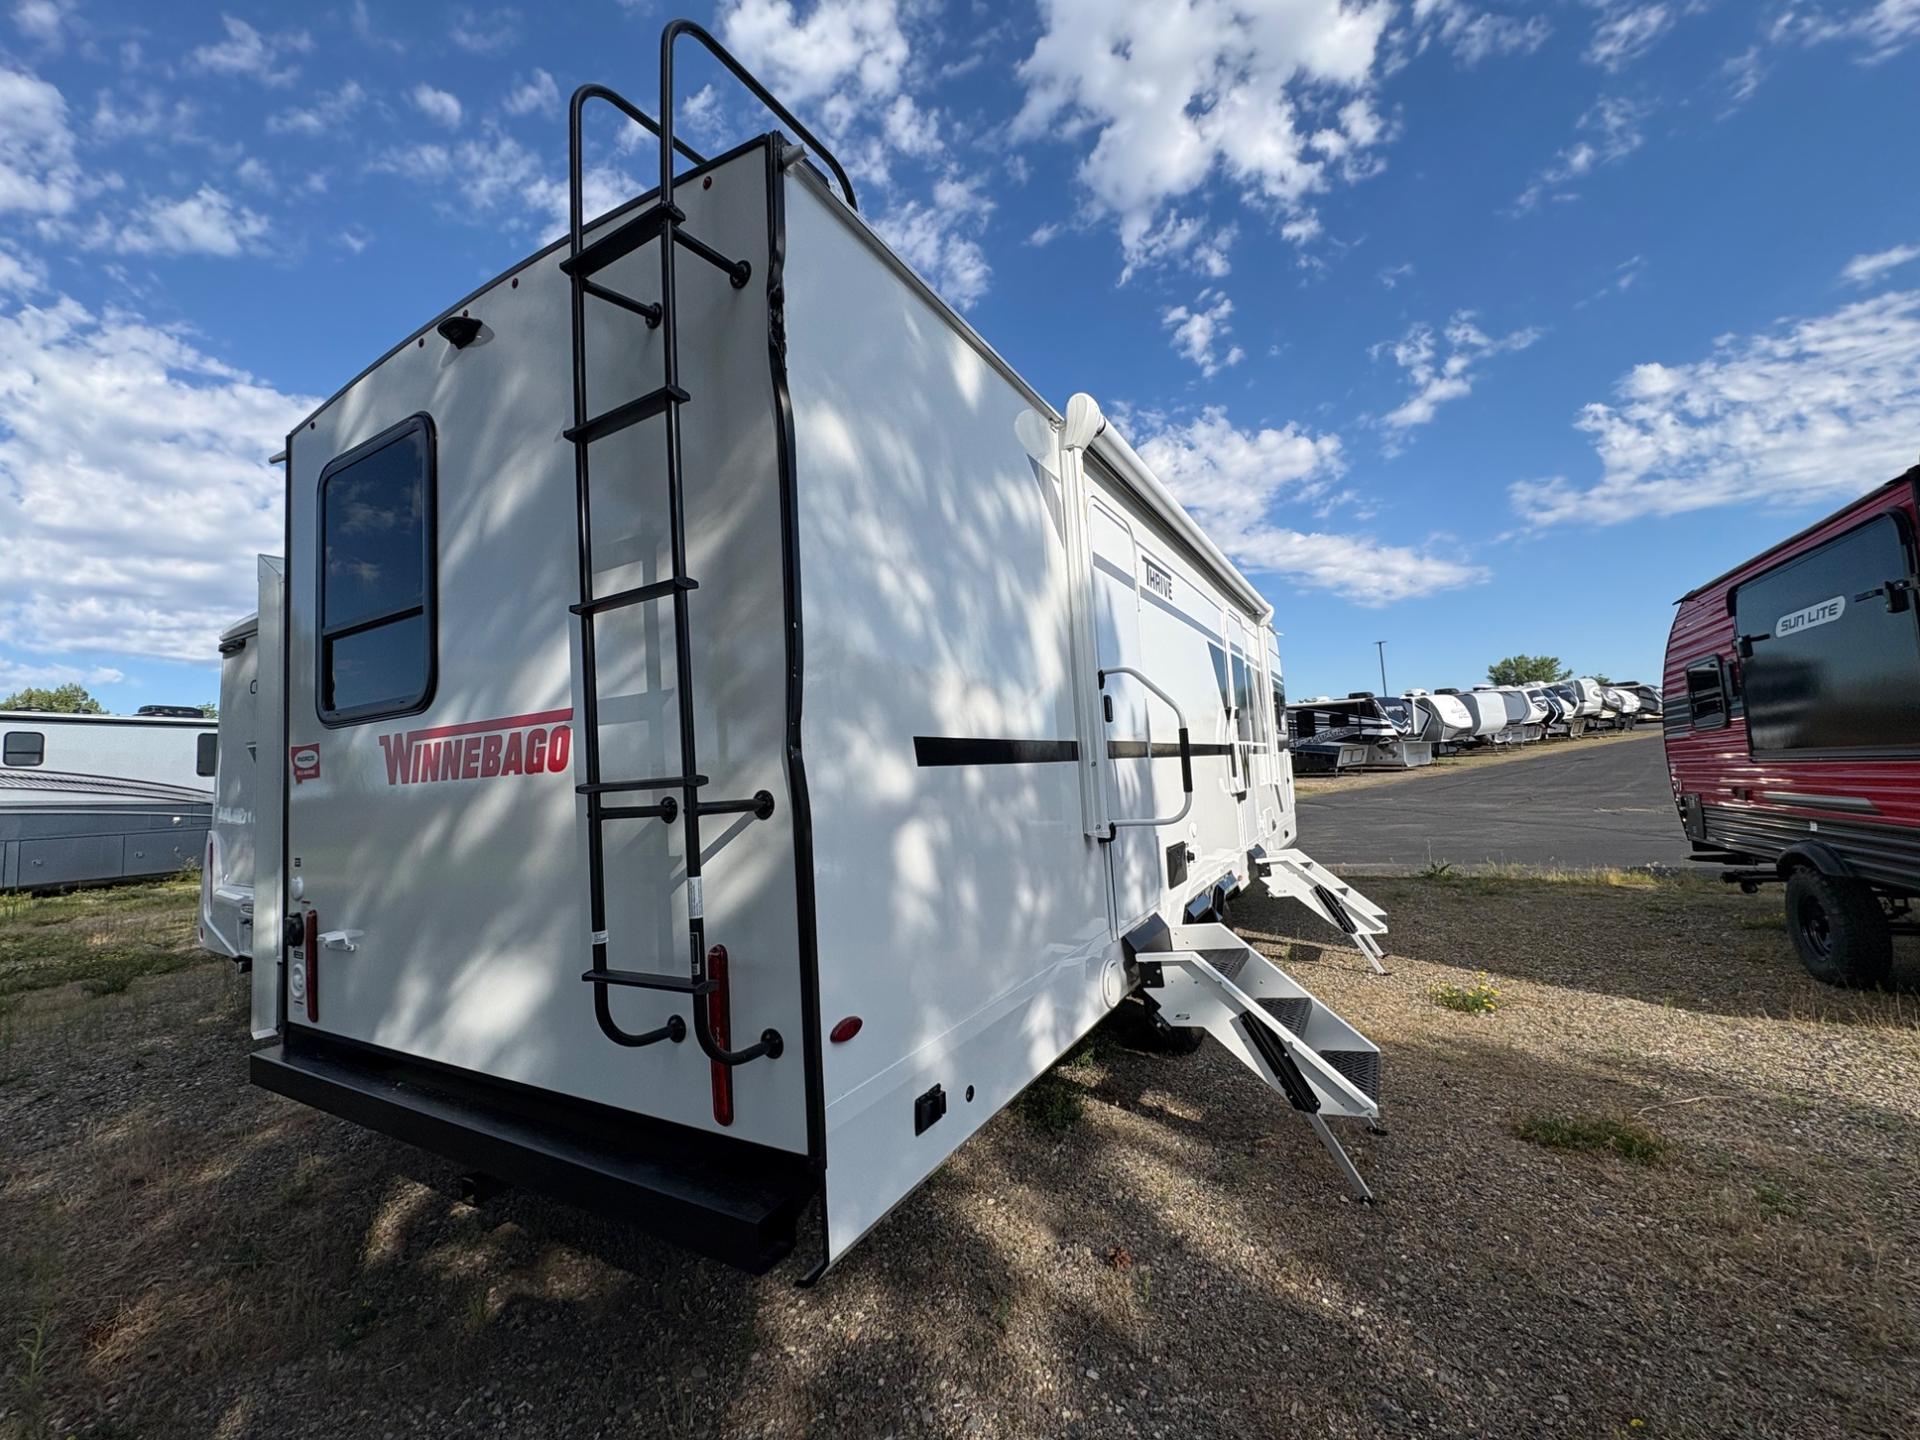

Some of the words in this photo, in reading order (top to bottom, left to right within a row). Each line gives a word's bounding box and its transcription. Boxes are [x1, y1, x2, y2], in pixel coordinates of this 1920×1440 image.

[1141, 554, 1173, 601] THRIVE
[1781, 614, 1805, 632] SUN
[1808, 602, 1839, 624] LITE
[379, 708, 574, 786] WINNEBAGO
